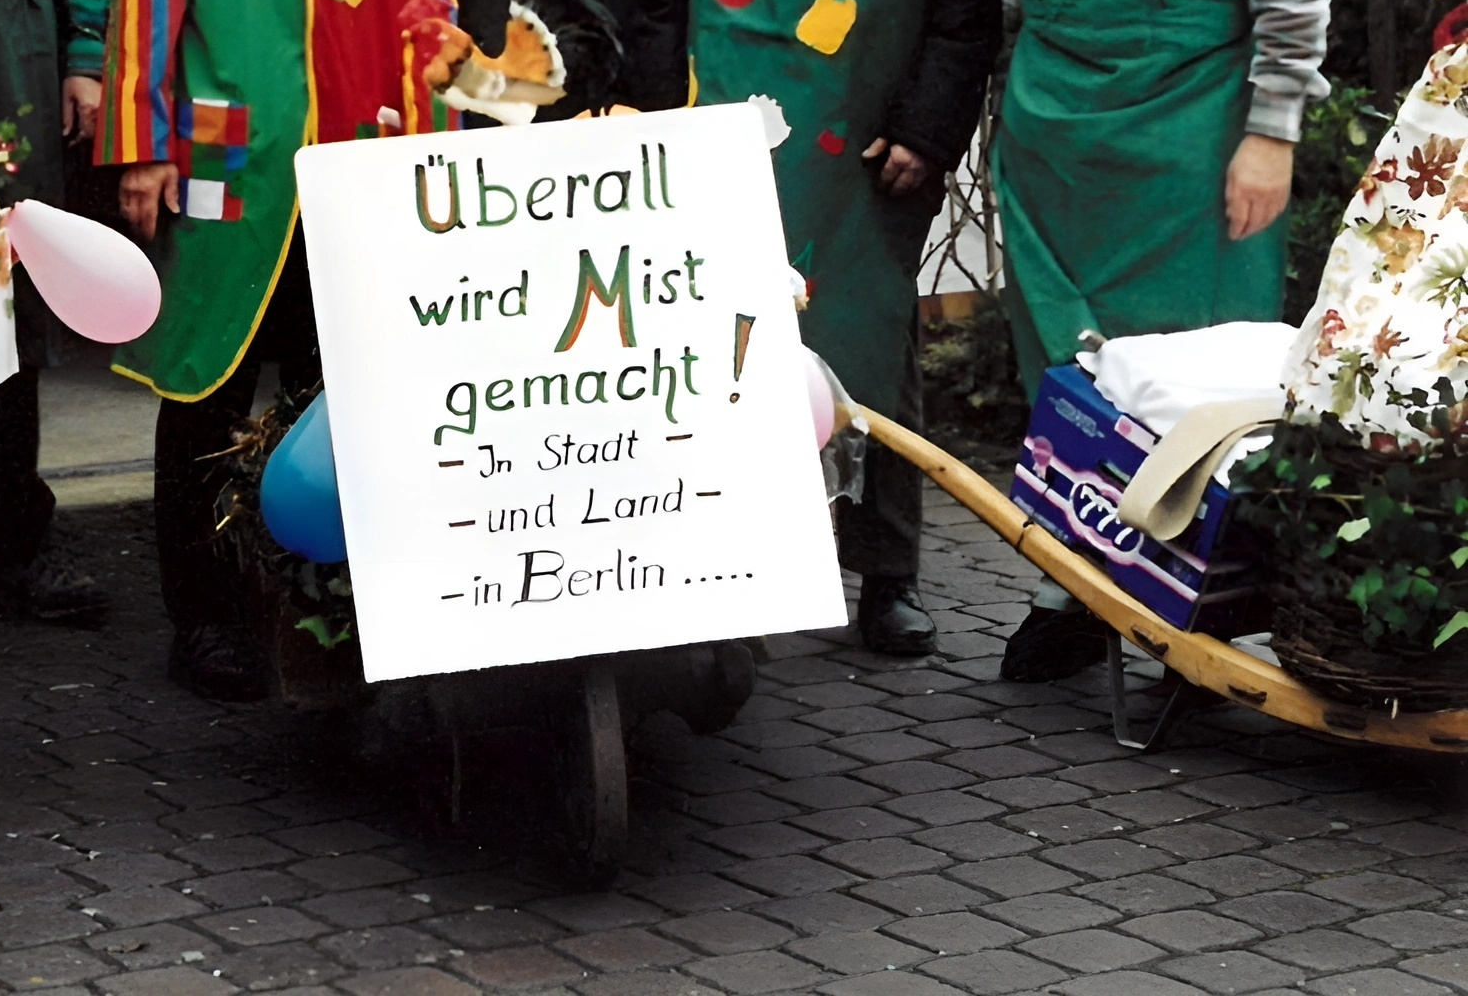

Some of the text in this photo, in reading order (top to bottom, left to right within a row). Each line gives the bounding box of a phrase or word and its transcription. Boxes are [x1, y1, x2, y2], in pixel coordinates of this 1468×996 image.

[414, 143, 675, 233] Überall
[409, 245, 705, 352] wird Mist
[537, 430, 639, 471] Stadt
